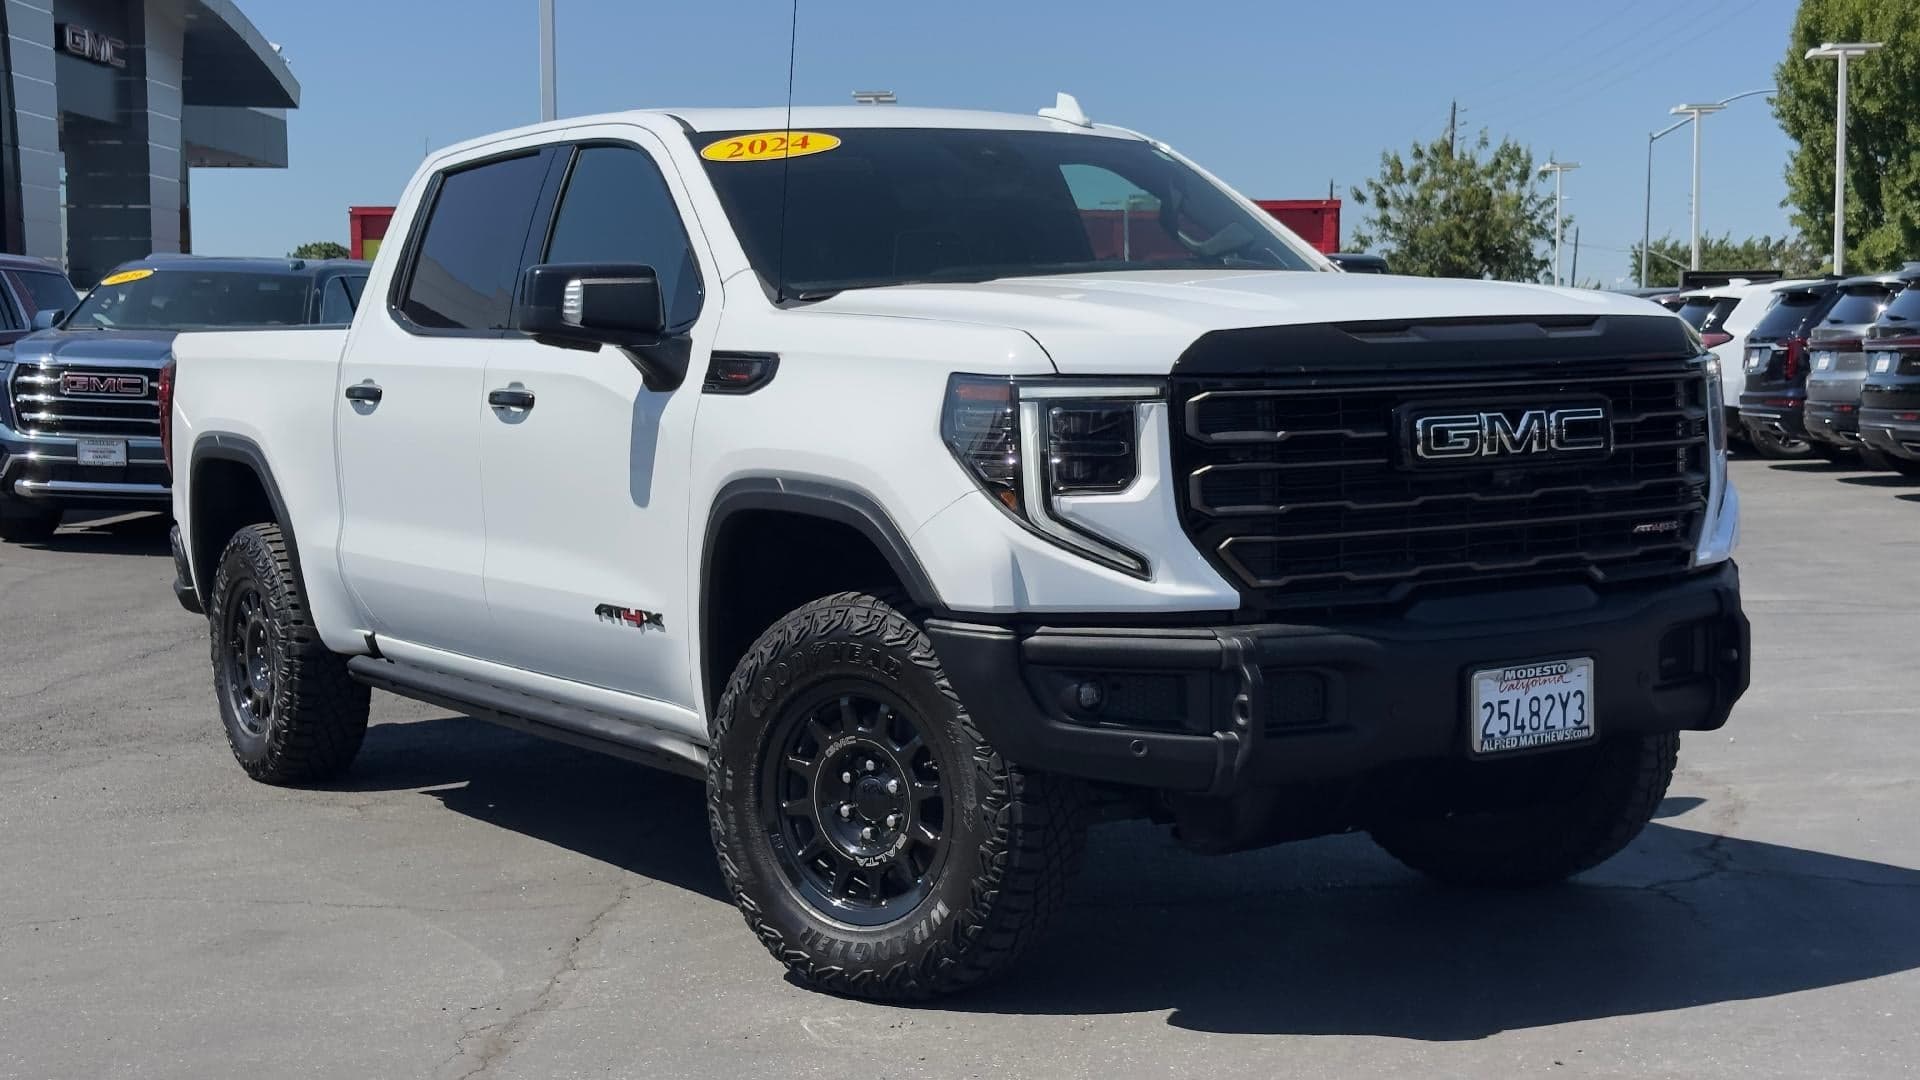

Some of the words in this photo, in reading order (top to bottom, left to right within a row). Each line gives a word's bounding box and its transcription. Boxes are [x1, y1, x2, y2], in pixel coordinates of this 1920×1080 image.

[65, 24, 126, 68] GMC
[727, 135, 810, 158] 2024
[65, 376, 141, 393] GMC
[1416, 408, 1603, 458] GMC
[595, 603, 662, 628] AT4X
[1504, 663, 1567, 681] MODESTO
[1499, 674, 1571, 695] California
[1481, 689, 1585, 739] 25482Y3
[825, 736, 856, 757] GMC
[801, 899, 950, 962] WRANGLER
